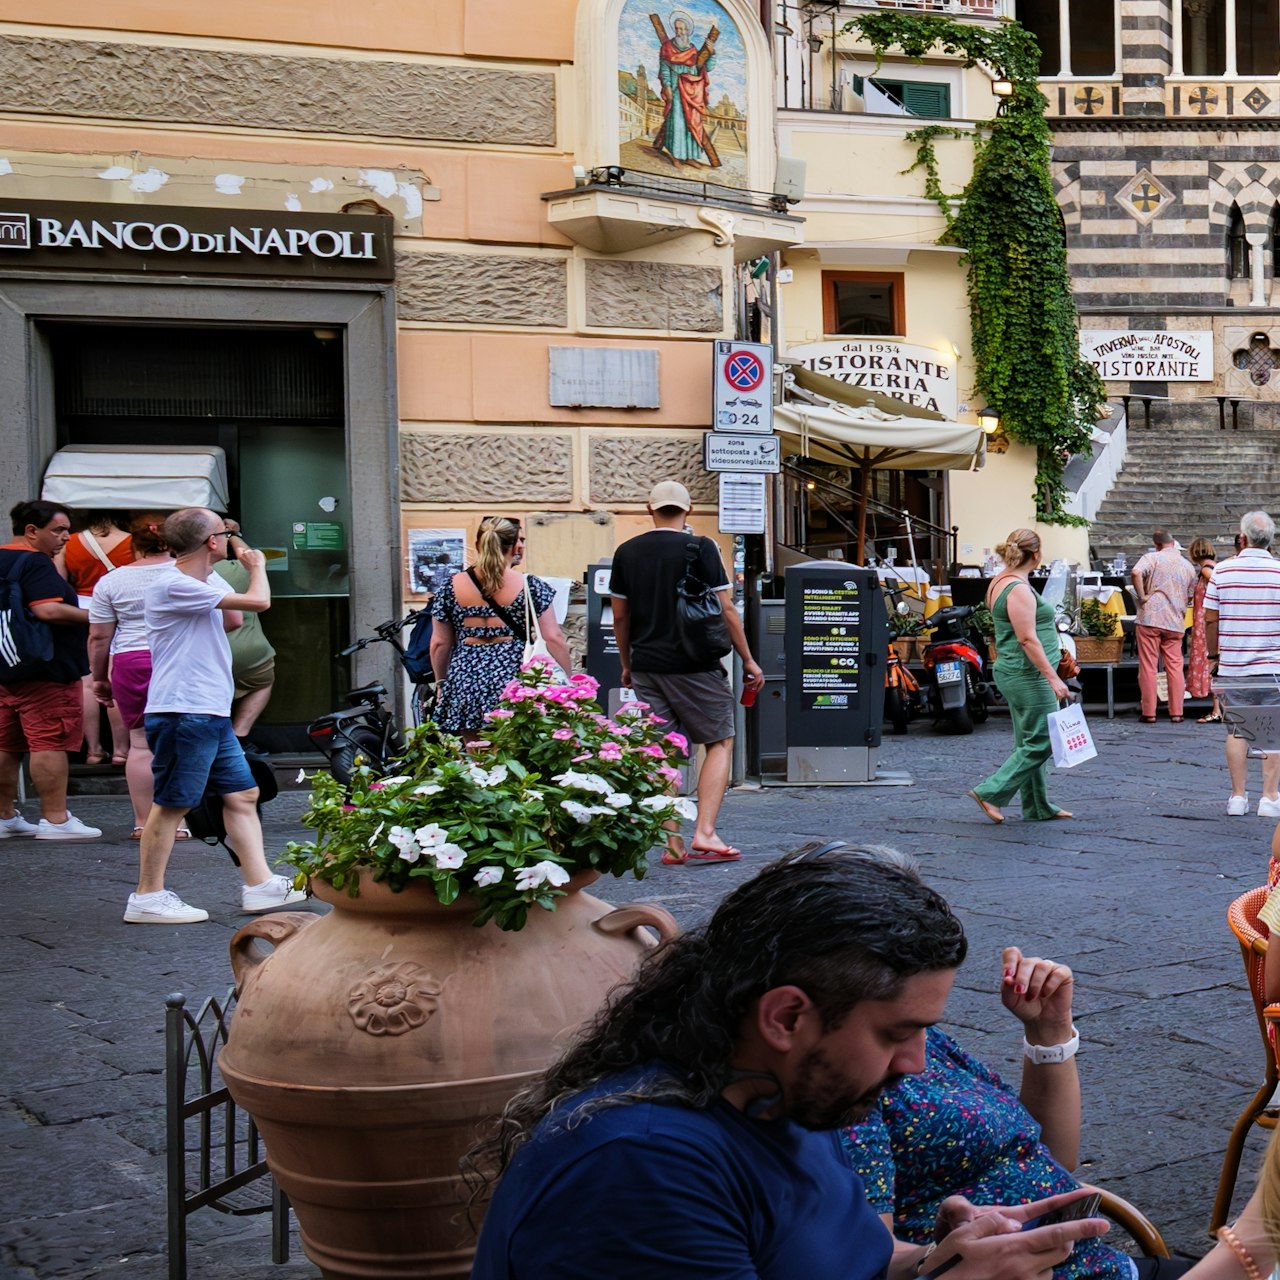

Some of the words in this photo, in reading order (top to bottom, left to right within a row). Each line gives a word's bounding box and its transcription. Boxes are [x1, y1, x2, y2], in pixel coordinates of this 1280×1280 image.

[37, 217, 190, 252] BANCO
[191, 231, 226, 253] DI
[229, 226, 377, 259] NAPOLI
[842, 344, 862, 352] dal
[869, 344, 900, 354] 1934
[1093, 334, 1138, 357] TAVERNA
[801, 355, 950, 381] ISTORANTE
[1093, 361, 1199, 377] RISTORANTE
[829, 373, 928, 393] IZZERIA
[711, 448, 750, 456] sottoposta
[711, 457, 775, 466] videosorveglianza
